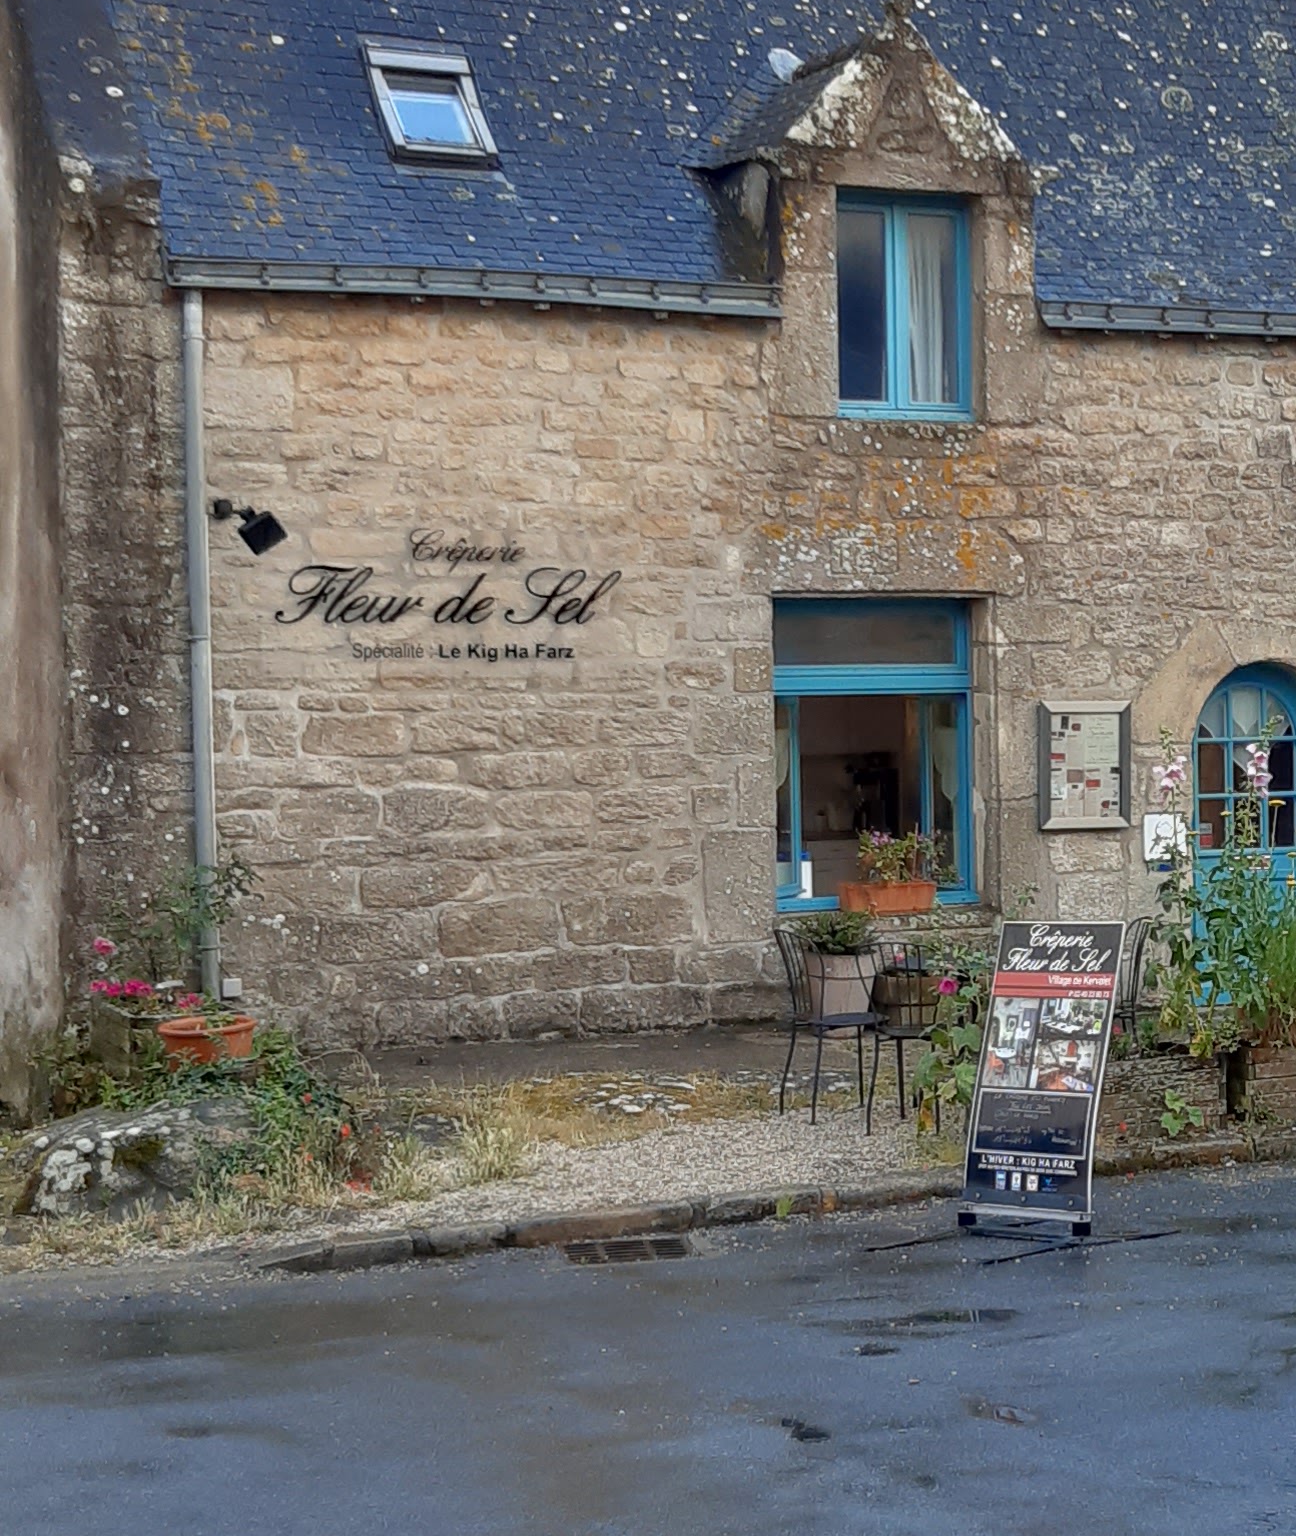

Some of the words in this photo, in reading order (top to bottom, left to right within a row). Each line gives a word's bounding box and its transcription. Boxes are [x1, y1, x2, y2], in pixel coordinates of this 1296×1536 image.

[409, 528, 526, 572] Crêperie
[275, 565, 424, 625] Fleur
[433, 573, 494, 625] de
[504, 566, 622, 625] Sel
[351, 642, 424, 662] Spécialité
[438, 644, 461, 659] Le
[467, 643, 498, 662] Kig
[504, 643, 529, 659] Ha
[535, 643, 575, 659] Farz
[1029, 924, 1095, 955] Crêperie
[1002, 947, 1049, 971] Fleur
[1048, 950, 1070, 972] de
[1071, 948, 1113, 972] Sel
[1048, 974, 1072, 987] Village
[981, 1154, 1014, 1165] L'HIVER
[1038, 1158, 1051, 1168] HA
[1052, 1159, 1076, 1170] FARZ
